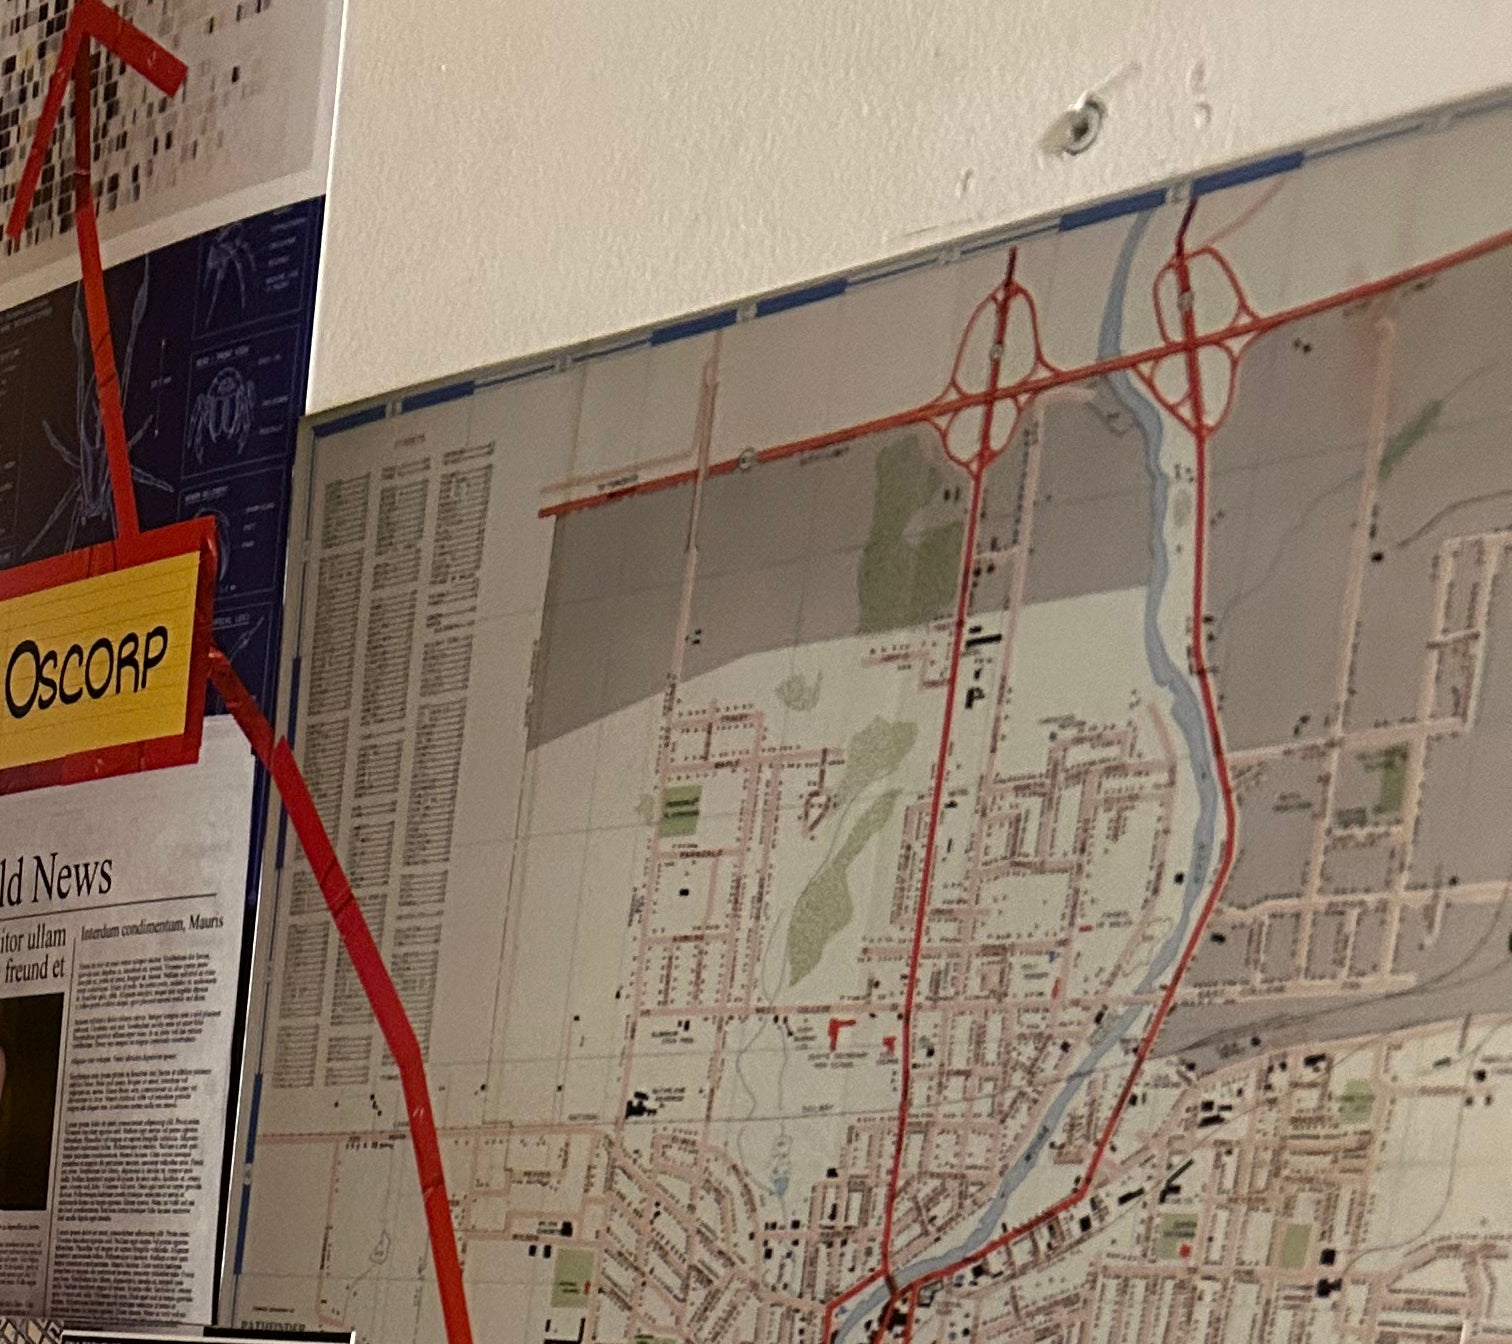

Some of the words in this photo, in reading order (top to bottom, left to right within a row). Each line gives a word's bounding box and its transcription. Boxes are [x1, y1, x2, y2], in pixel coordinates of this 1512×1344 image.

[32, 852, 113, 903] News
[189, 914, 224, 930] Mauris
[27, 924, 66, 950] ullam
[5, 957, 49, 985] freund
[52, 956, 65, 978] et
